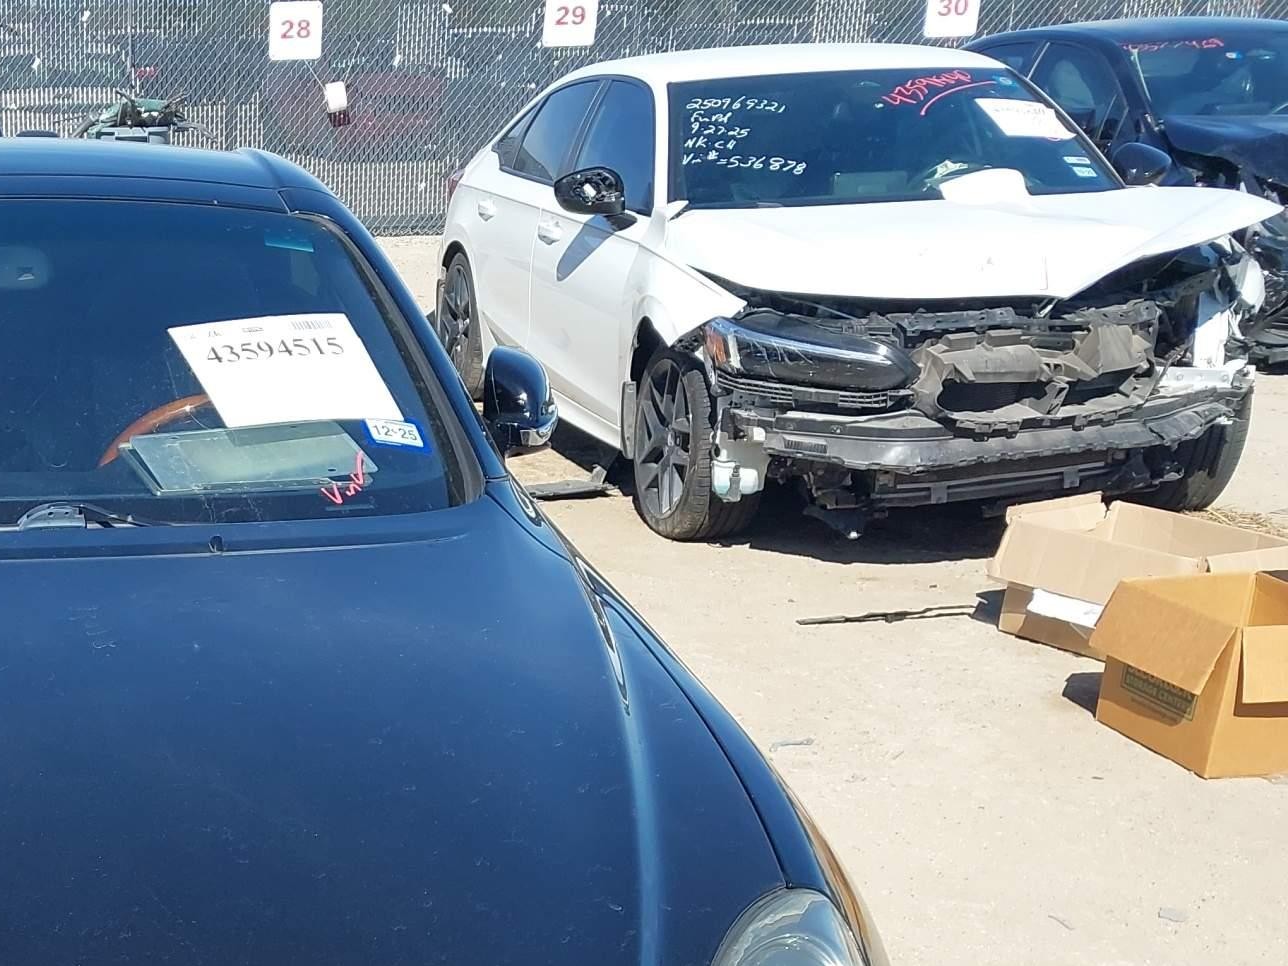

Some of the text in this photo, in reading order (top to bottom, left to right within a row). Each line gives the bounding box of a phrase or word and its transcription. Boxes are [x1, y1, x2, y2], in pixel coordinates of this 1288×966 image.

[555, 5, 586, 26] 29
[937, 0, 968, 16] 30
[280, 19, 311, 39] 28
[206, 337, 344, 363] 43594515
